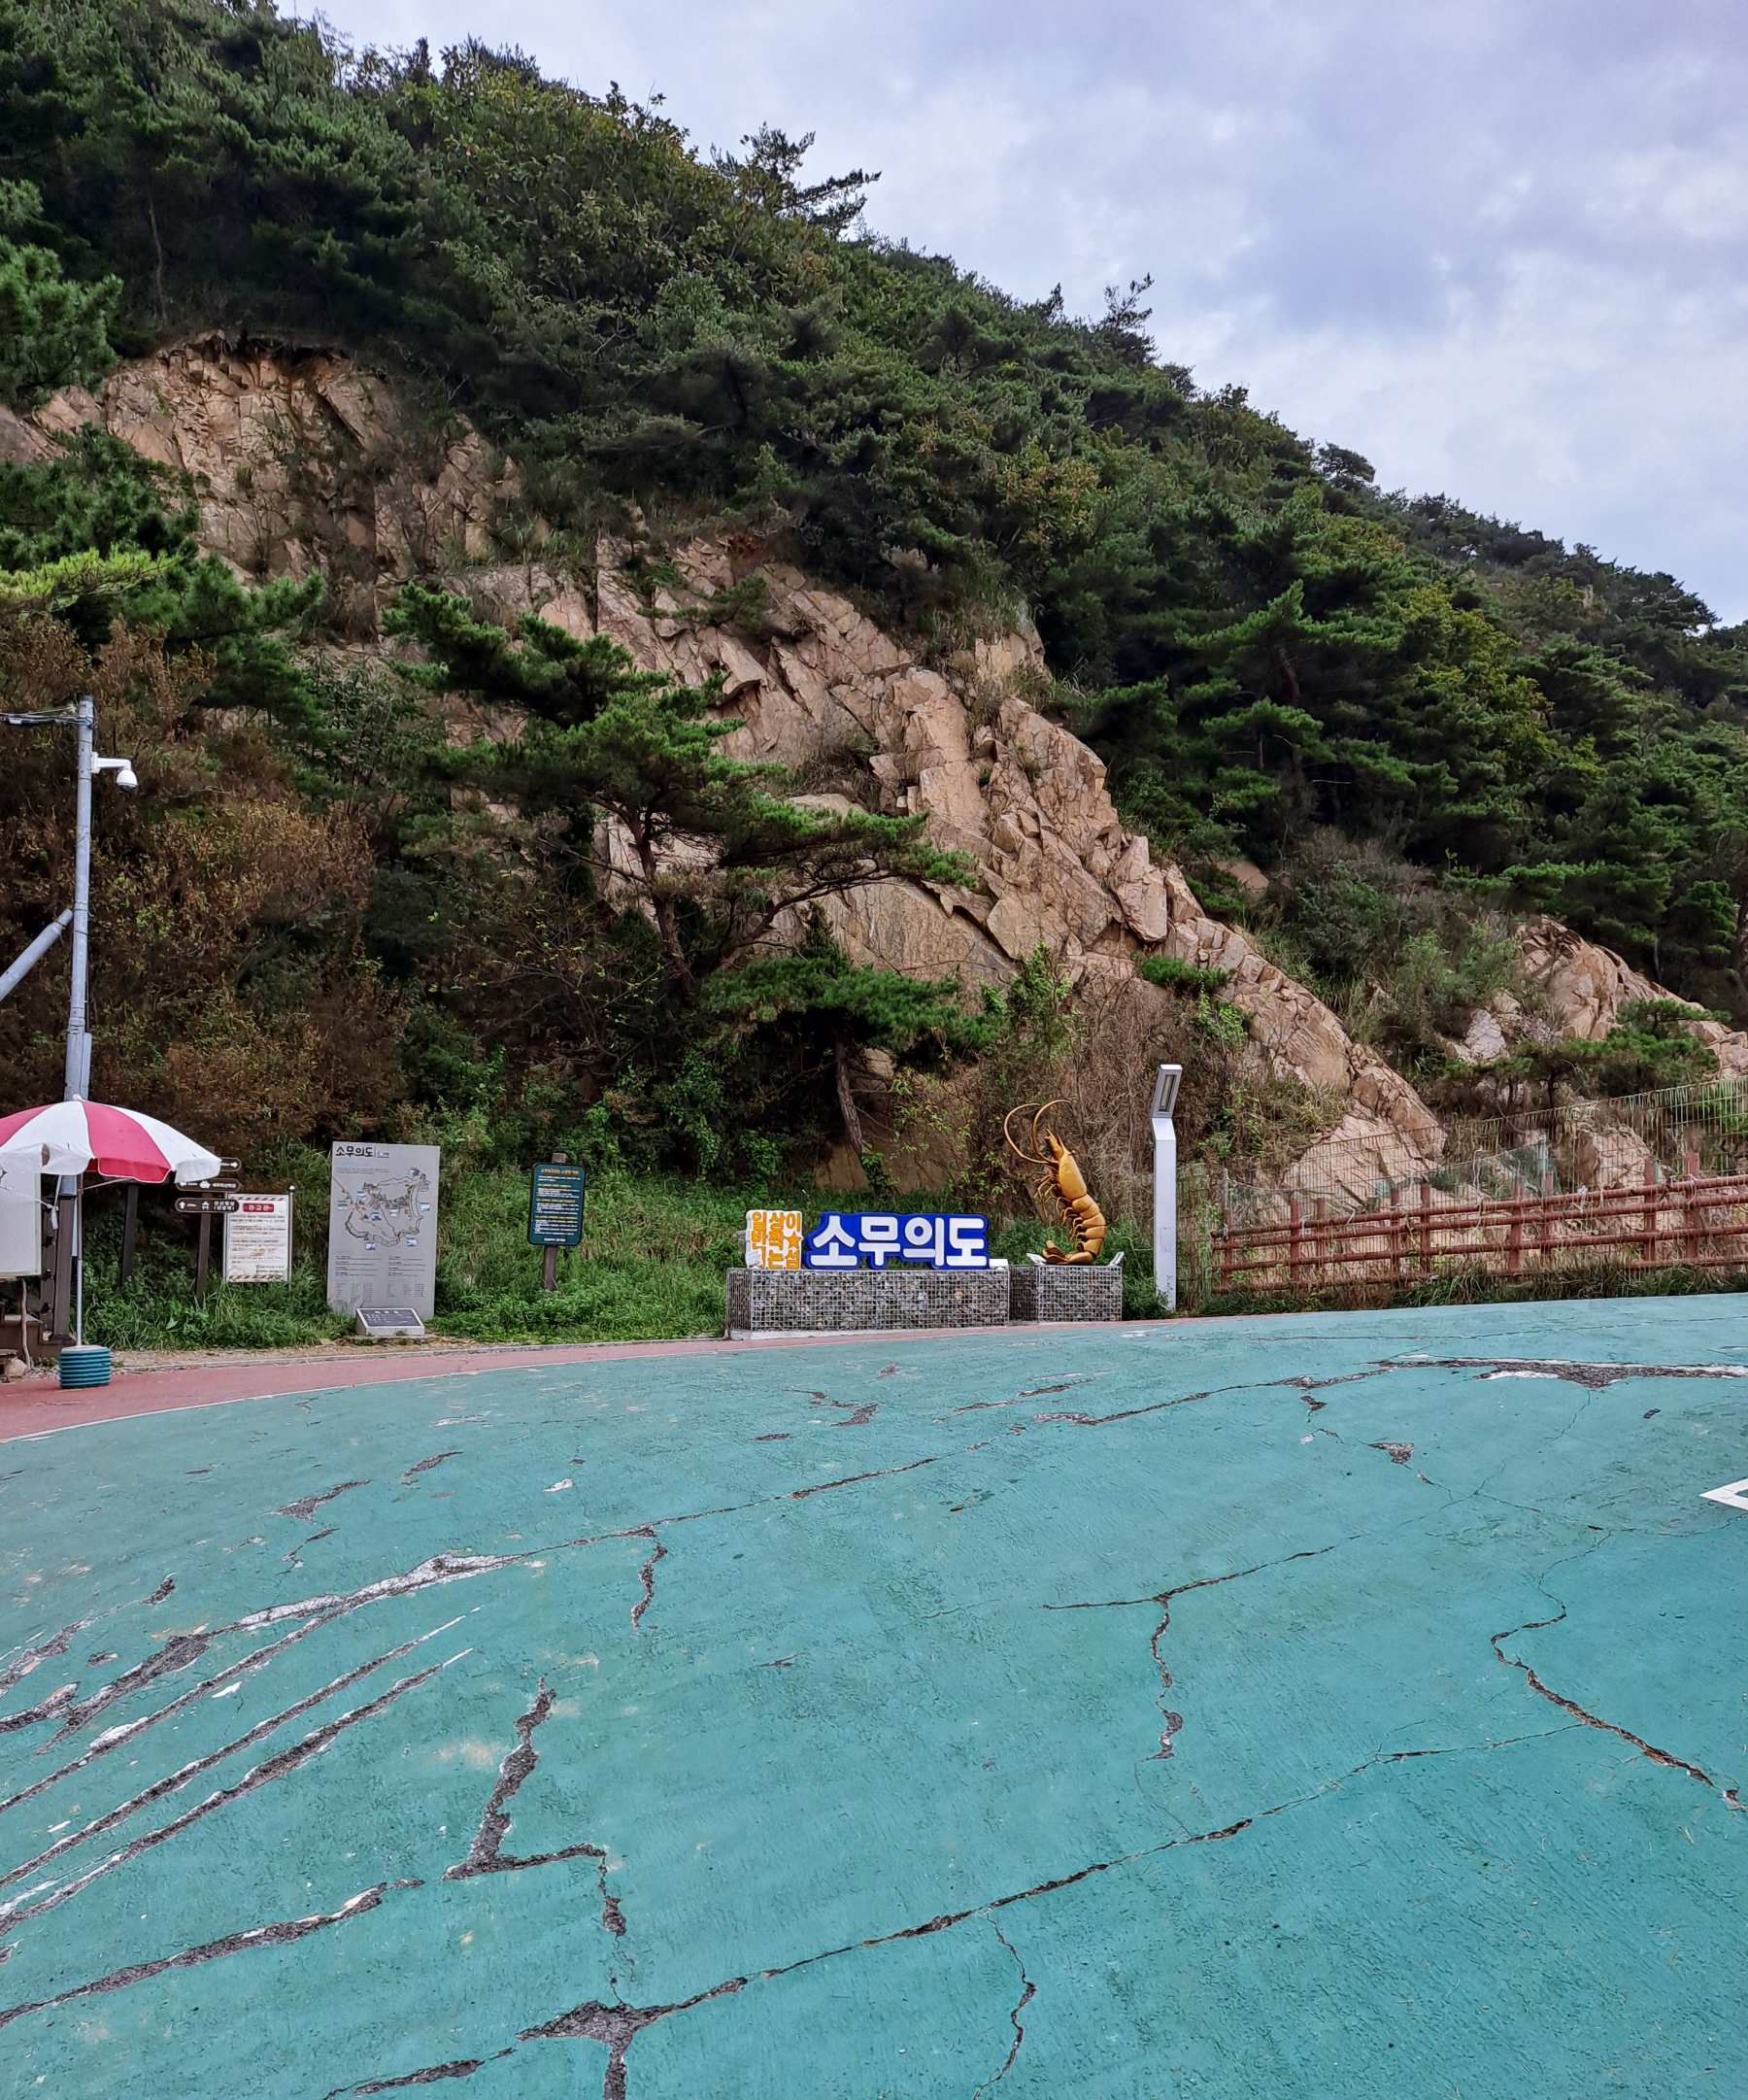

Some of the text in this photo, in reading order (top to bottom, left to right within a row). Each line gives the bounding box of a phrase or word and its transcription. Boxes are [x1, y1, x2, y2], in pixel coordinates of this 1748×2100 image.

[335, 1145, 373, 1157] 소무의도
[752, 1211, 800, 1232] 일상이
[810, 1215, 987, 1267] 소무의도
